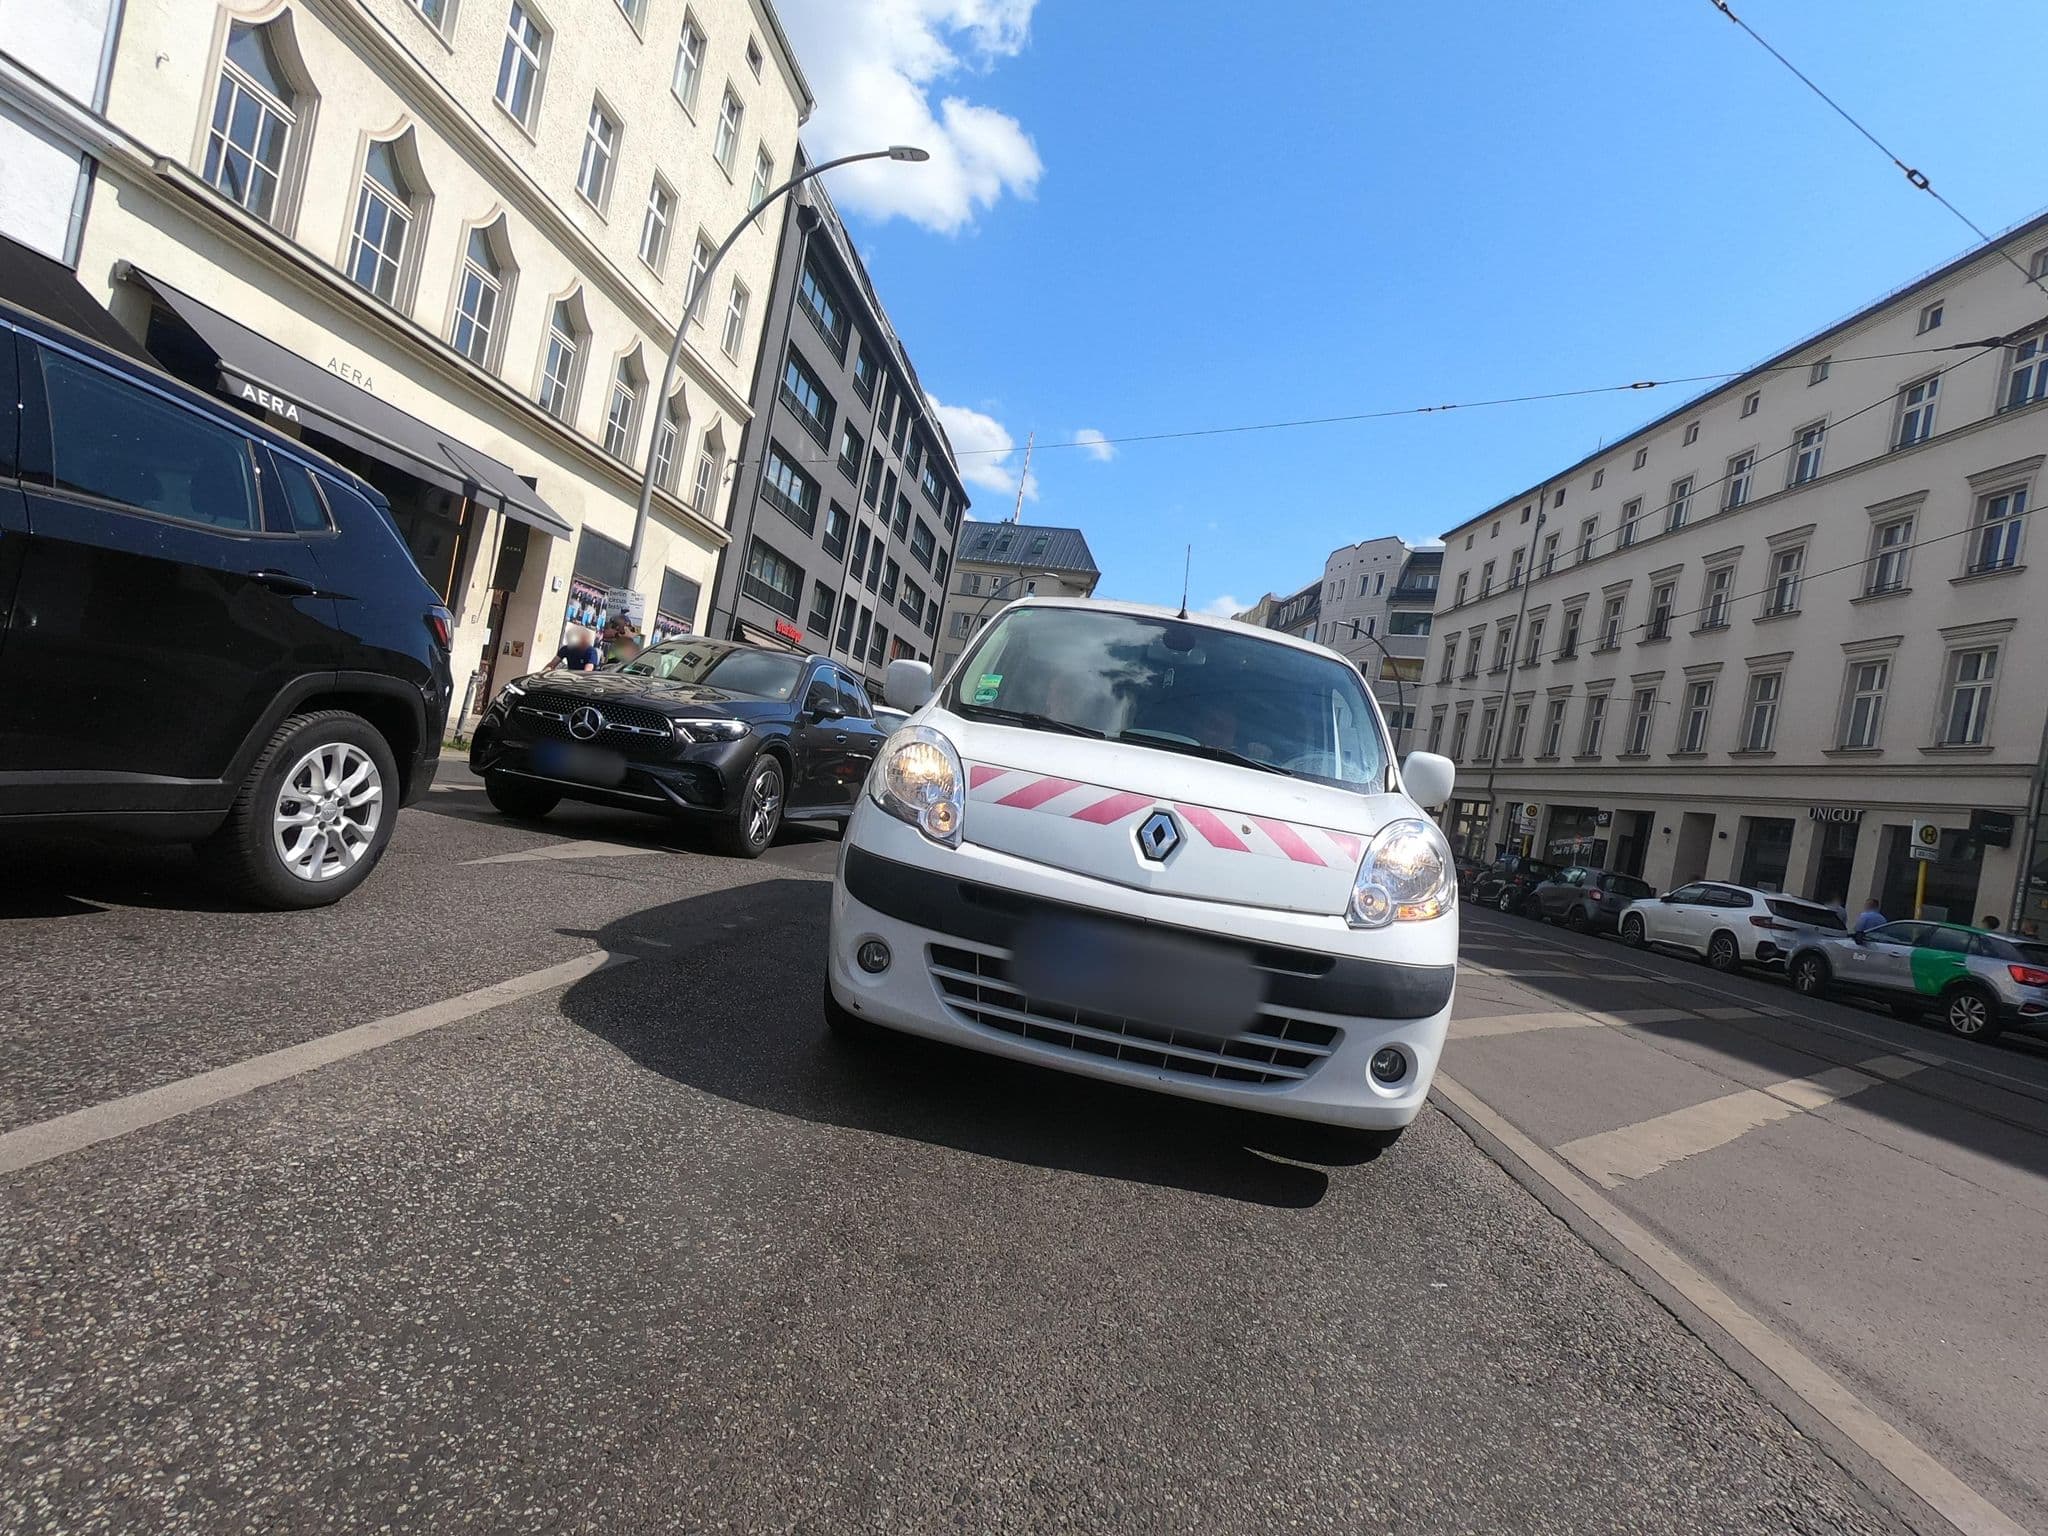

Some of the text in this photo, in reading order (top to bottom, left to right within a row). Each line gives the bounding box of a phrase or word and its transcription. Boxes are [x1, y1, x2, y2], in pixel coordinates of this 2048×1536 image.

[327, 357, 374, 391] AERA
[242, 383, 299, 422] AERA
[1808, 807, 1863, 821] UNICUT
